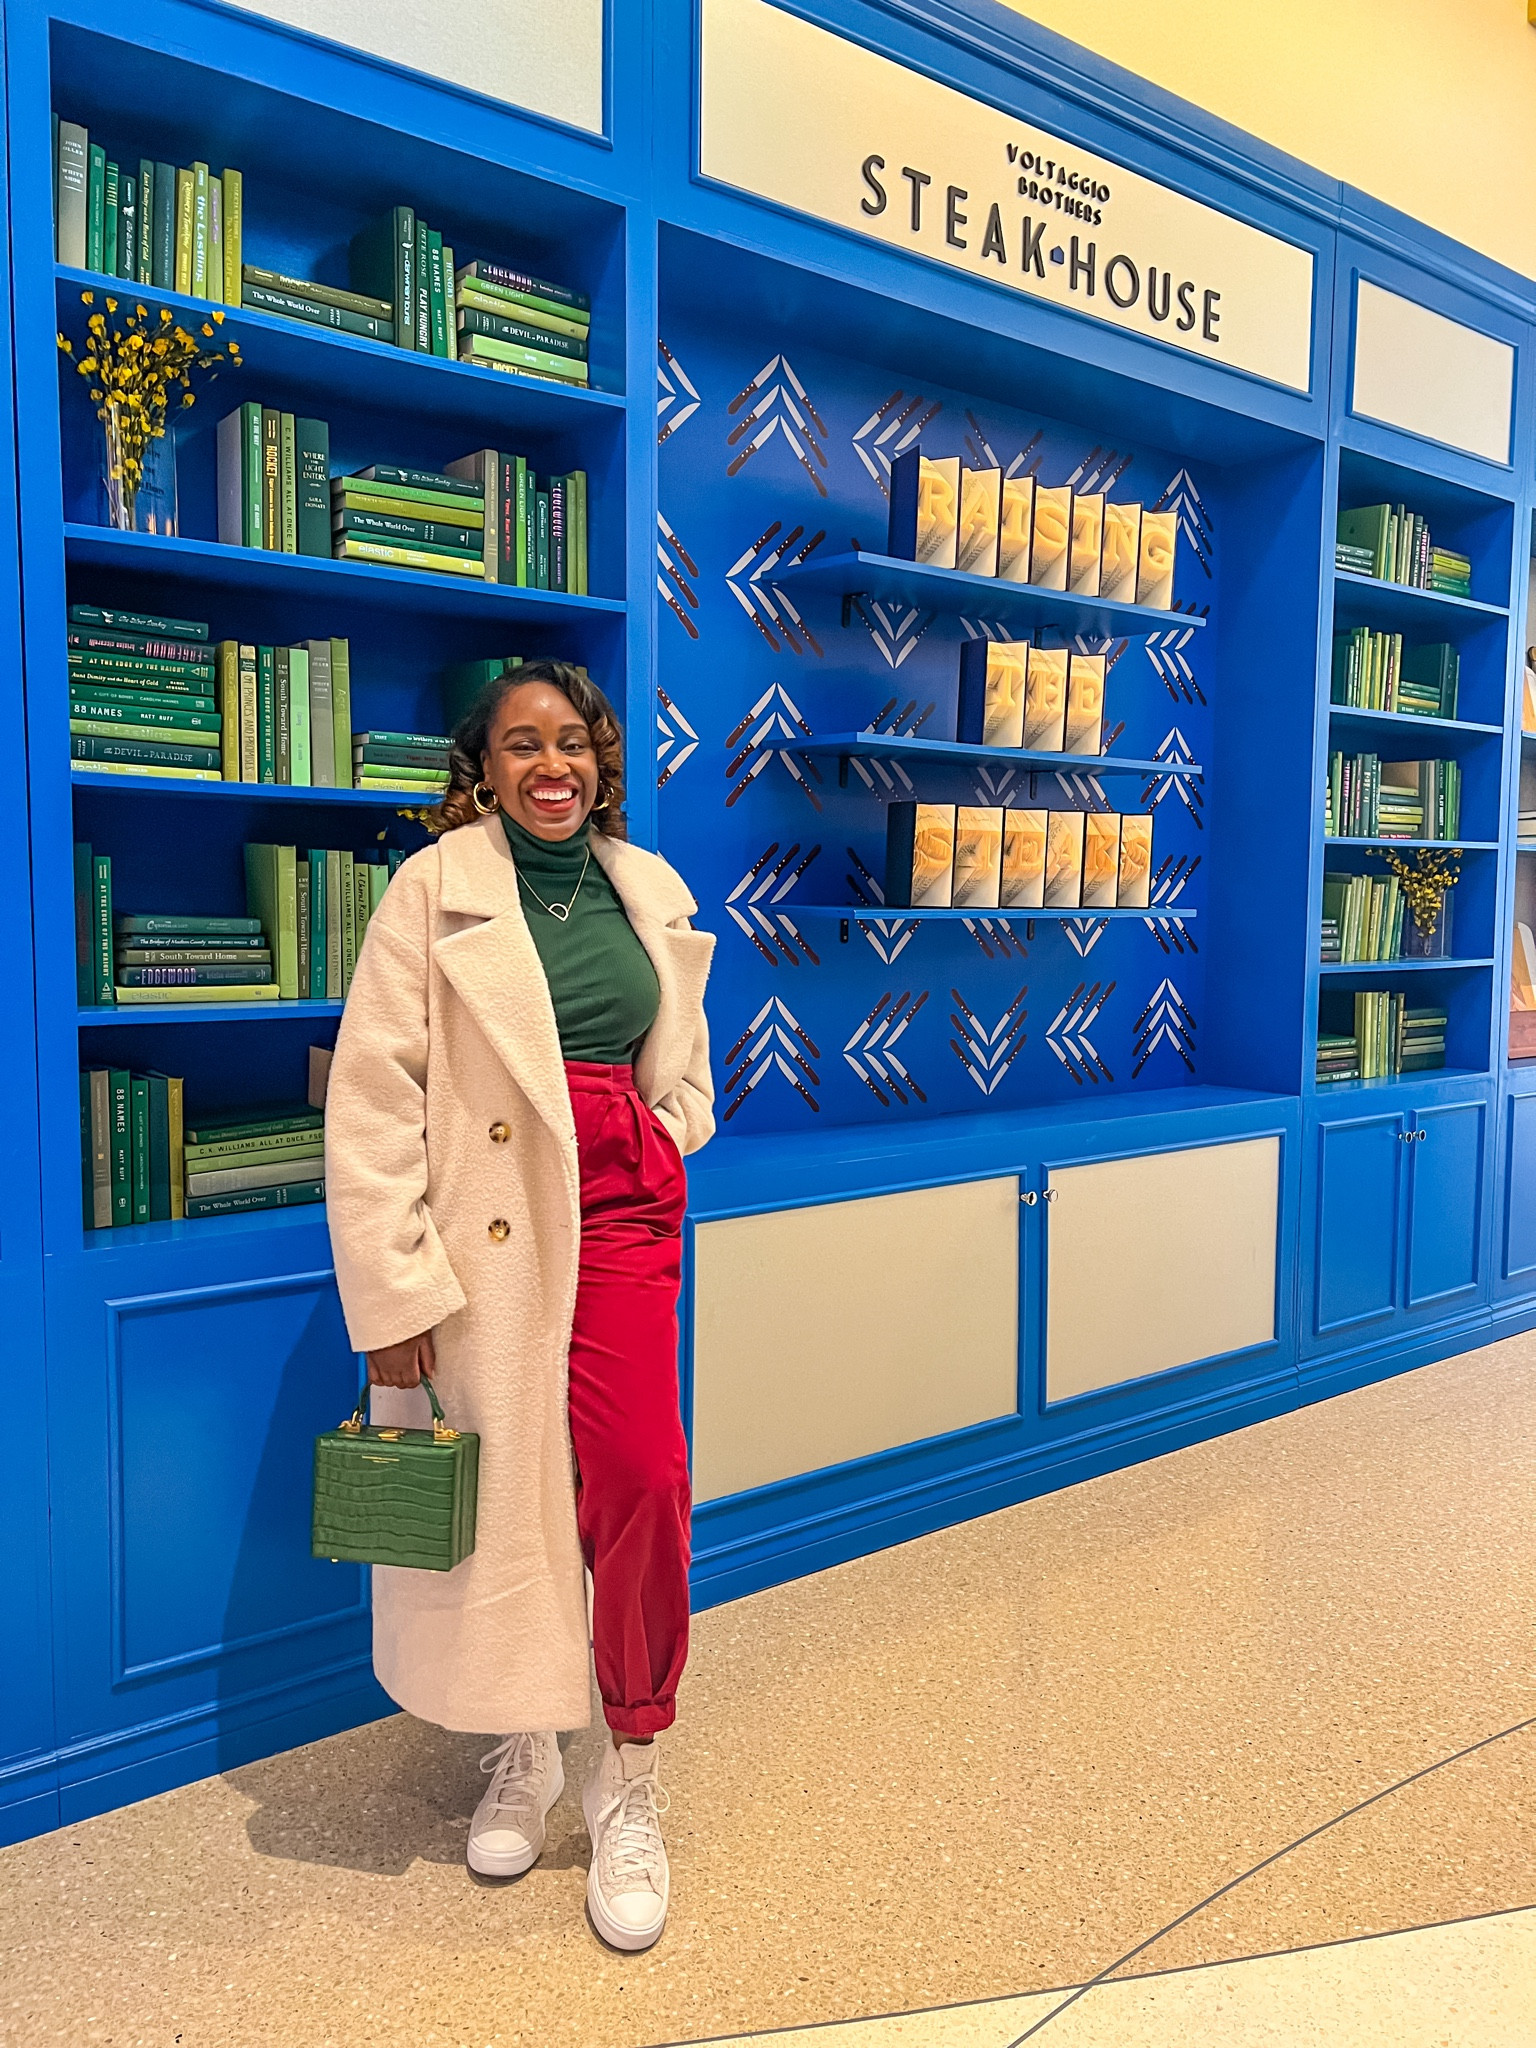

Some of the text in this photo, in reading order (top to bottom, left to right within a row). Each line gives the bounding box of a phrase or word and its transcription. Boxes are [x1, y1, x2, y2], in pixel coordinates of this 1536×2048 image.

[1006, 142, 1110, 202] VOLTAGGIO
[1018, 176, 1102, 225] BROTHERS
[432, 249, 441, 293] 88 NAMES
[446, 262, 454, 299] HUNGRY
[480, 282, 504, 294] GREEN
[504, 288, 525, 300] LIGHT
[252, 290, 320, 315] The Whole World Over
[419, 288, 428, 349] PLAY HUNGRY
[510, 327, 532, 340] DEVIL
[266, 445, 278, 477] ROCKET
[302, 451, 326, 461] WHERE
[302, 472, 326, 481] ENTERS
[305, 464, 324, 473] LIGHT
[286, 507, 292, 516] AT
[366, 518, 383, 528] Whole
[384, 521, 401, 530] World
[401, 524, 415, 533] Over
[918, 472, 1176, 574] RAISING
[358, 545, 394, 558] elastic
[115, 660, 132, 668] EDGE
[160, 665, 185, 674] HAIGHT
[243, 687, 254, 717] PRINCES
[74, 705, 123, 717] 88 NAMES
[280, 704, 288, 731] Toward
[243, 718, 254, 735] AND
[243, 735, 255, 771] PROMISES
[280, 733, 288, 756] Home
[114, 748, 193, 762] DEVIL PARADISE
[300, 915, 308, 941] Toward
[346, 938, 352, 948] AT
[160, 952, 237, 960] South Toward Home
[300, 944, 308, 965] Home
[141, 968, 197, 985] EDGEWOOD
[116, 1089, 126, 1133] 88 NAMES
[218, 1141, 255, 1151] WILLIAMS
[286, 1135, 305, 1143] ONCE
[212, 1201, 231, 1209] Whole
